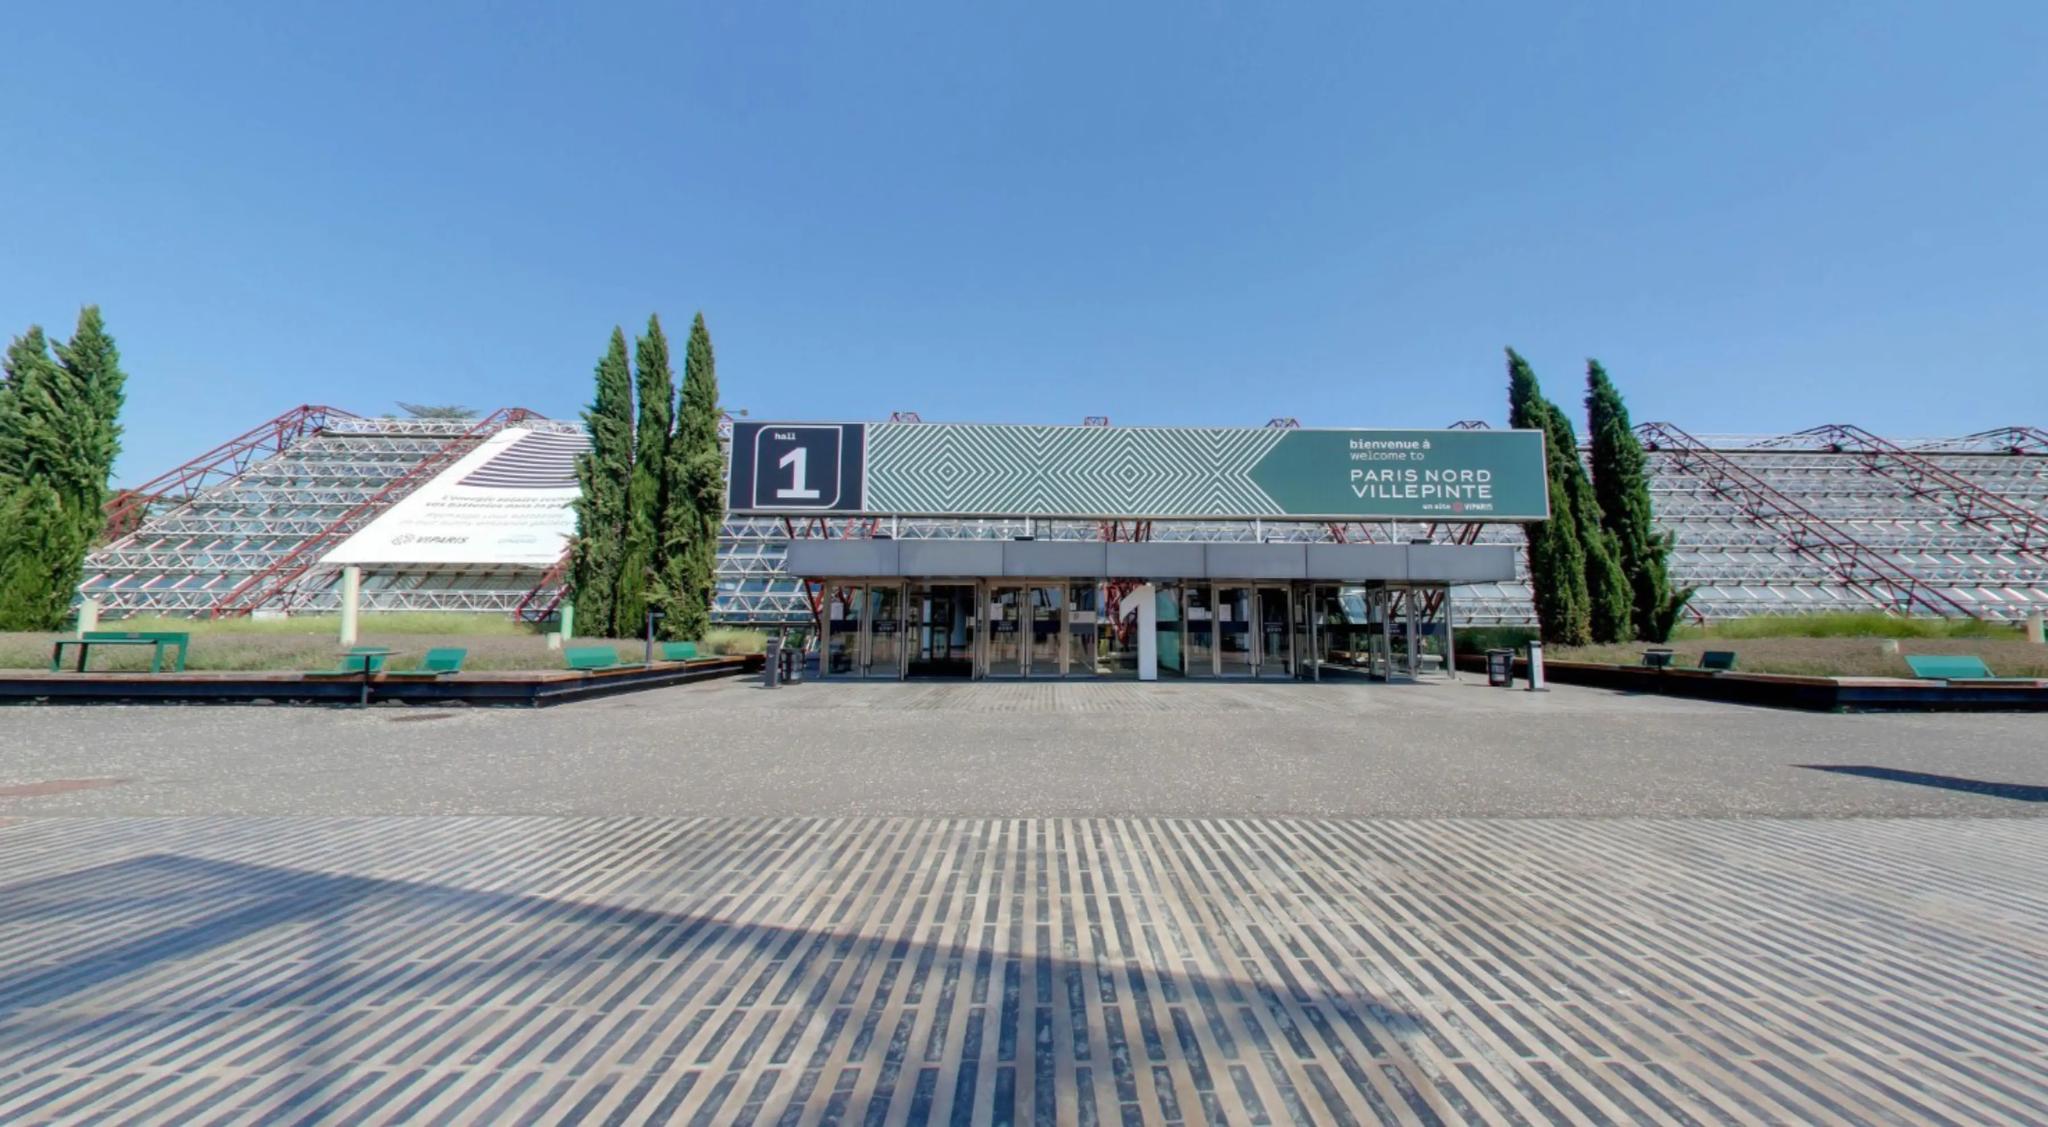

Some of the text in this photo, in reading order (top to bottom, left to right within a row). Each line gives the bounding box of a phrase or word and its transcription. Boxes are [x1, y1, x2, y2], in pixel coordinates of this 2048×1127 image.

[775, 432, 796, 440] hall
[1350, 439, 1431, 449] bienvenue à
[1350, 450, 1425, 461] welcome to
[777, 447, 820, 498] 1
[1350, 469, 1491, 482] PARIS NORD
[1351, 485, 1493, 498] VILLEPINTE
[1119, 583, 1157, 680] 1
